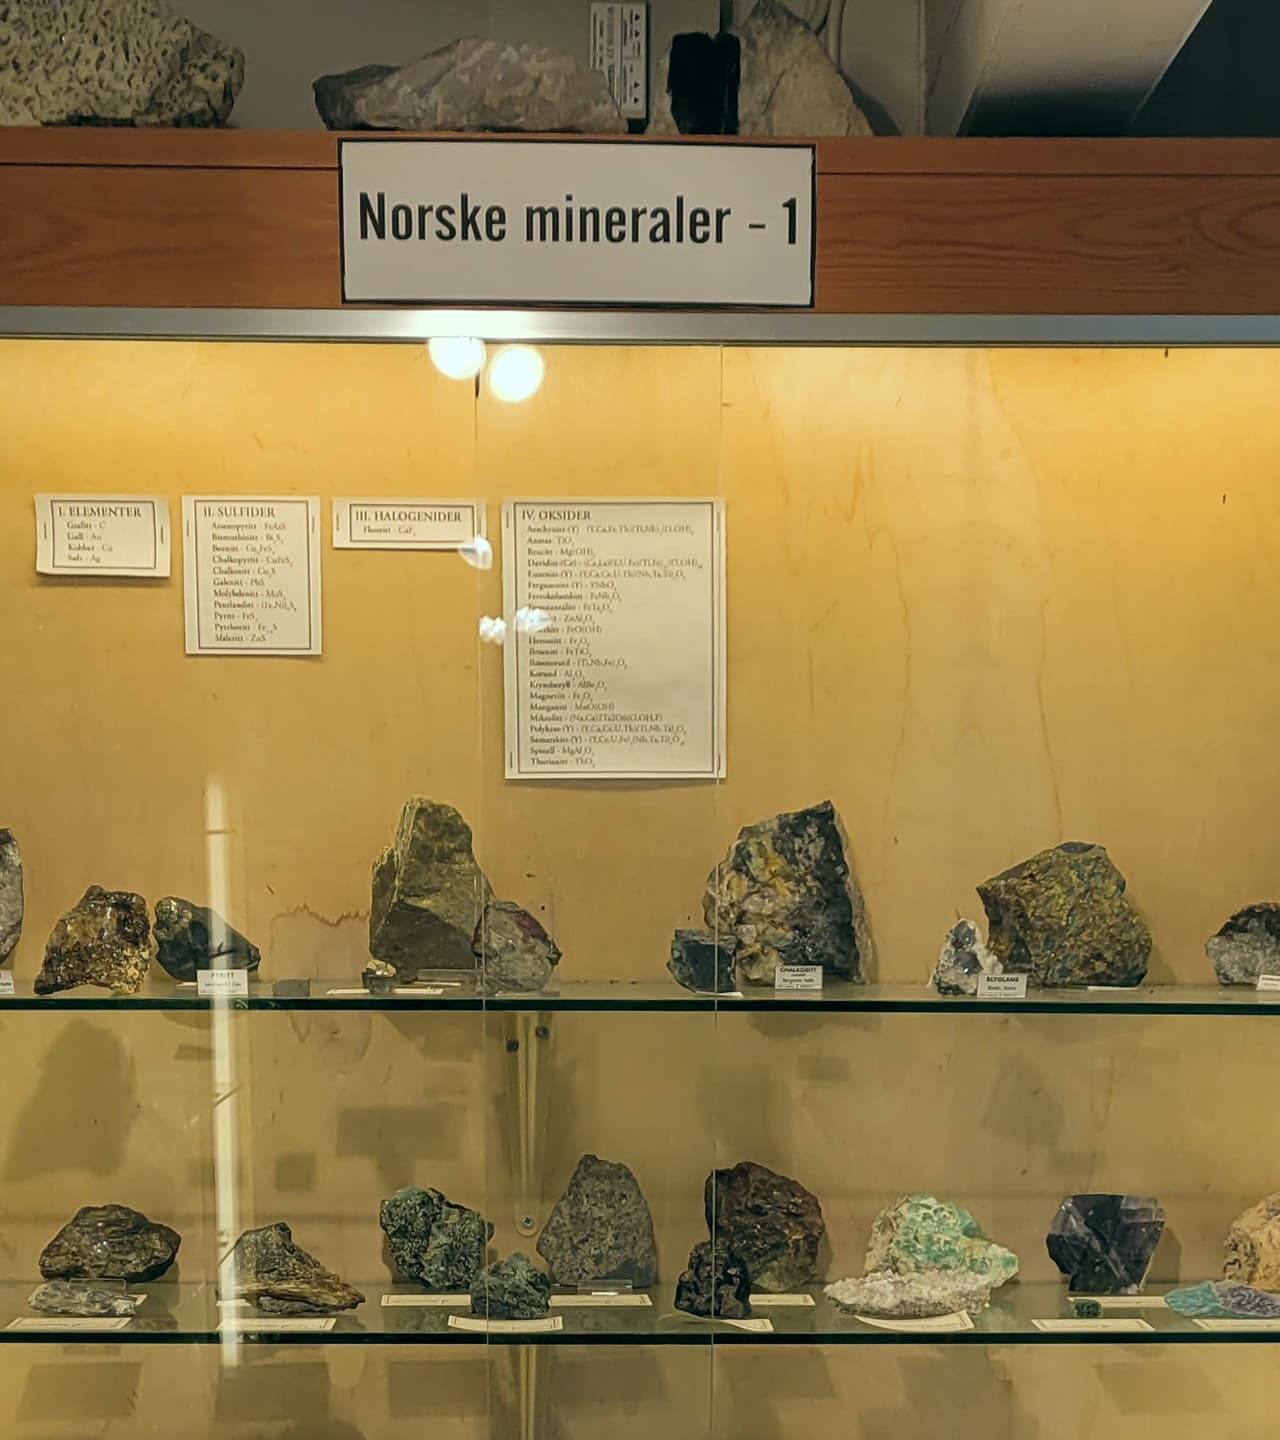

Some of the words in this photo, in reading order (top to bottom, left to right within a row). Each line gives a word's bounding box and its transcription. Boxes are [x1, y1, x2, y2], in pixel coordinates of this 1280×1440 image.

[359, 192, 508, 242] Norske
[525, 193, 732, 243] mineraler
[782, 196, 798, 245] 1
[58, 506, 66, 517] I.
[69, 506, 142, 517] ELEMENTER
[203, 506, 214, 517] II.
[217, 506, 276, 517] SULFIDER
[355, 511, 370, 521] III.
[374, 511, 462, 522] HALOGENIDER
[522, 510, 535, 520] IV.
[539, 510, 592, 521] OKSIDER
[99, 521, 106, 529] C
[67, 532, 84, 540] Gull
[212, 555, 259, 566] Chalkopyritt
[213, 578, 243, 586] Galenitt
[214, 590, 258, 598] Molybdenitt
[214, 612, 235, 622] Pyritt
[530, 670, 558, 678] Korund
[530, 692, 566, 701] Magnetitt
[530, 704, 568, 712] Manganitt
[530, 746, 556, 756] Spinell
